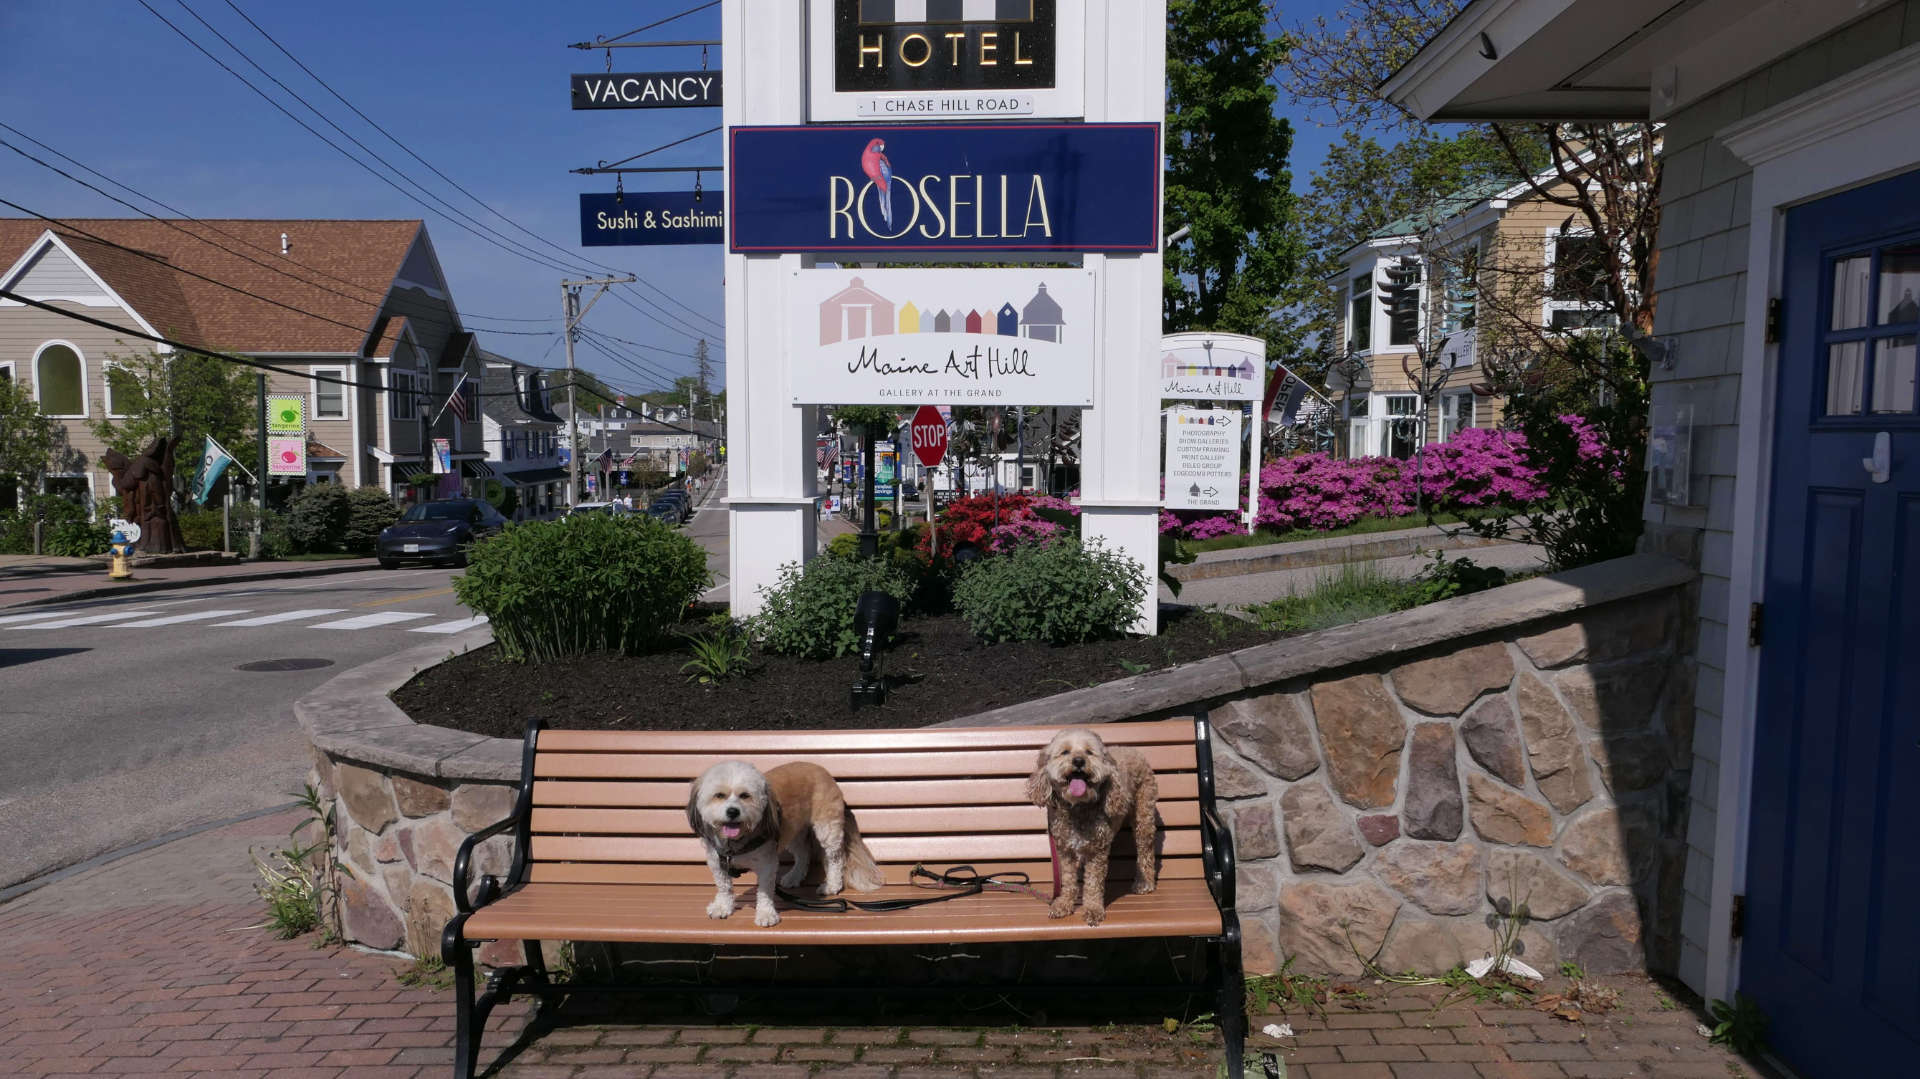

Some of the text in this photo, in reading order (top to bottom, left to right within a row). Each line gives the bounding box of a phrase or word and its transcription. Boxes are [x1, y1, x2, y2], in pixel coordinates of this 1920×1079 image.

[858, 32, 1033, 68] HOTEL
[585, 76, 713, 103] VACANCY
[871, 98, 1019, 112] 1 CHASE HILL ROAD
[597, 209, 723, 230] Sushi & Sashimi
[830, 174, 1053, 240] ROSELLA
[848, 345, 1035, 379] Maine Art Hill
[879, 388, 1003, 397] GALLERY AT THE GRAND
[1164, 380, 1245, 395] Maine Art Hill
[1272, 376, 1297, 413] OPEN
[913, 423, 945, 449] STOP
